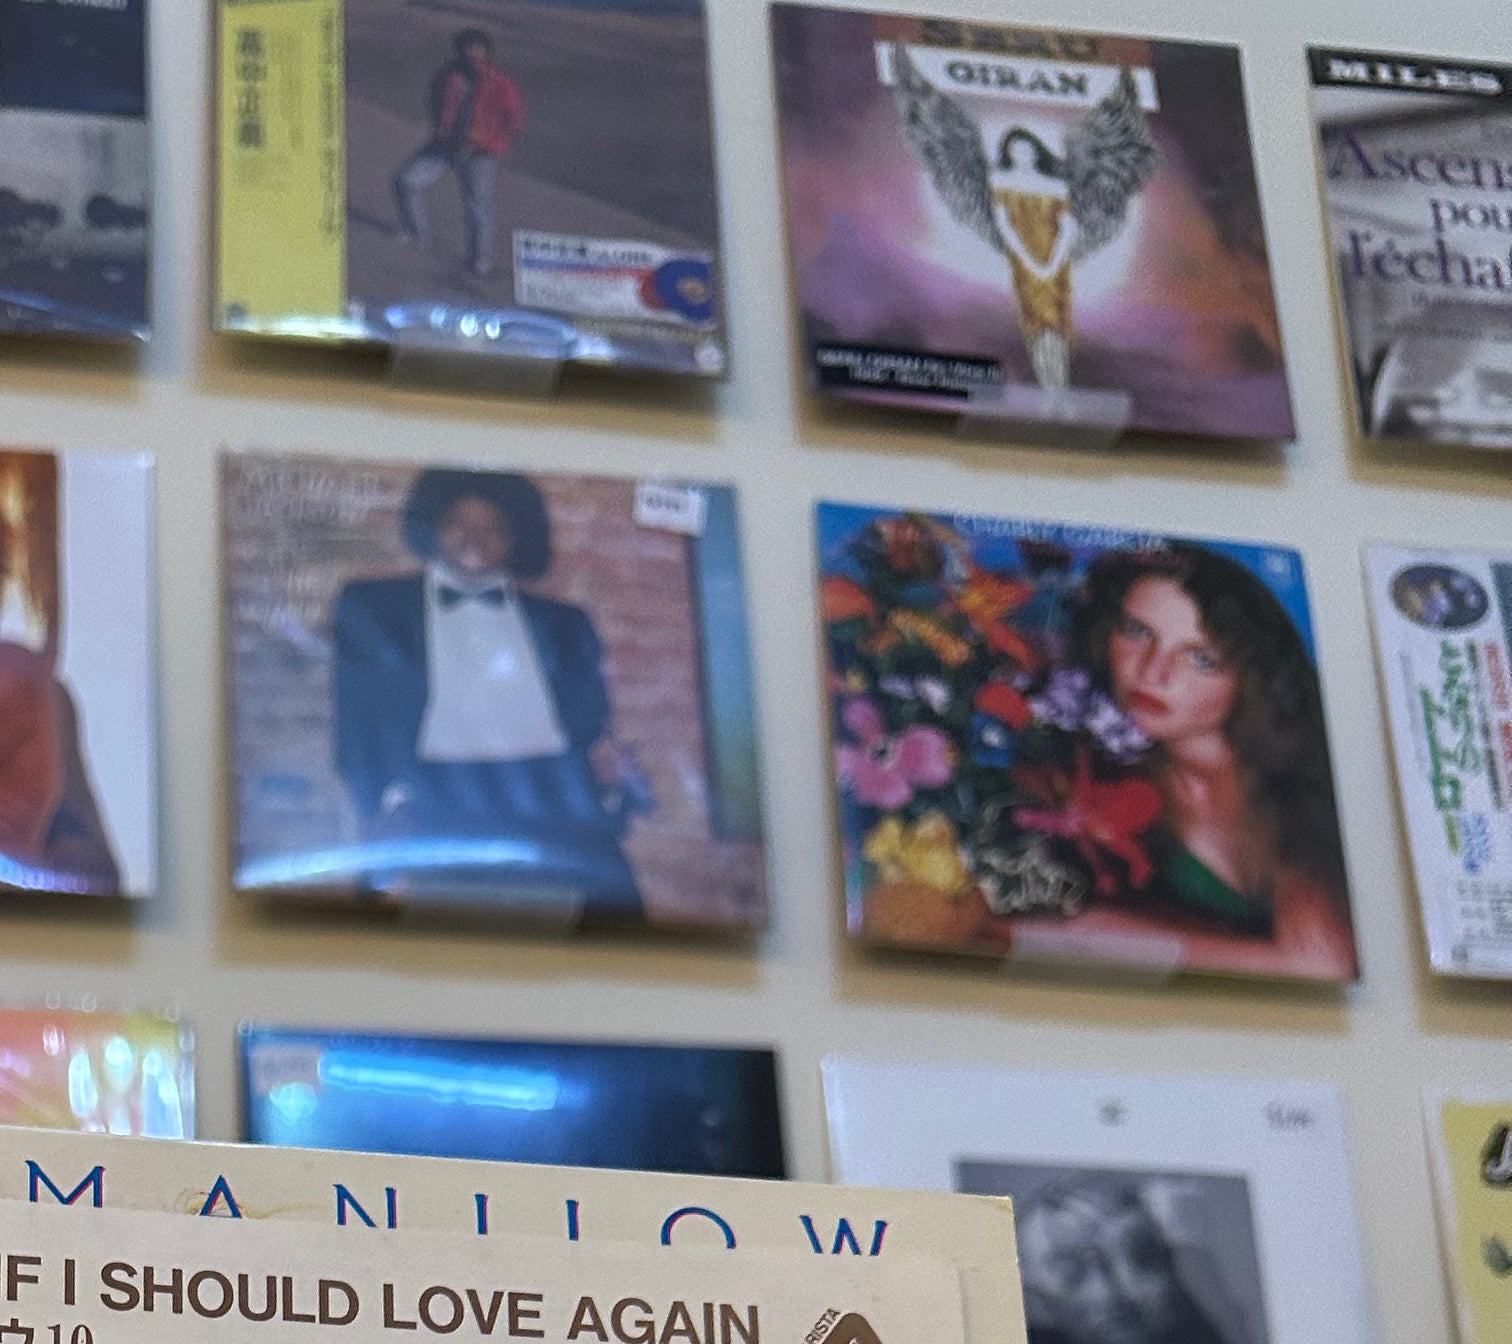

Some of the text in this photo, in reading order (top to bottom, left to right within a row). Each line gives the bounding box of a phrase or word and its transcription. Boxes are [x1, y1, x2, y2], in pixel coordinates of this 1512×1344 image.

[63, 1258, 76, 1306] I
[99, 1261, 360, 1326] SHOULD
[382, 1282, 545, 1339] LOVE
